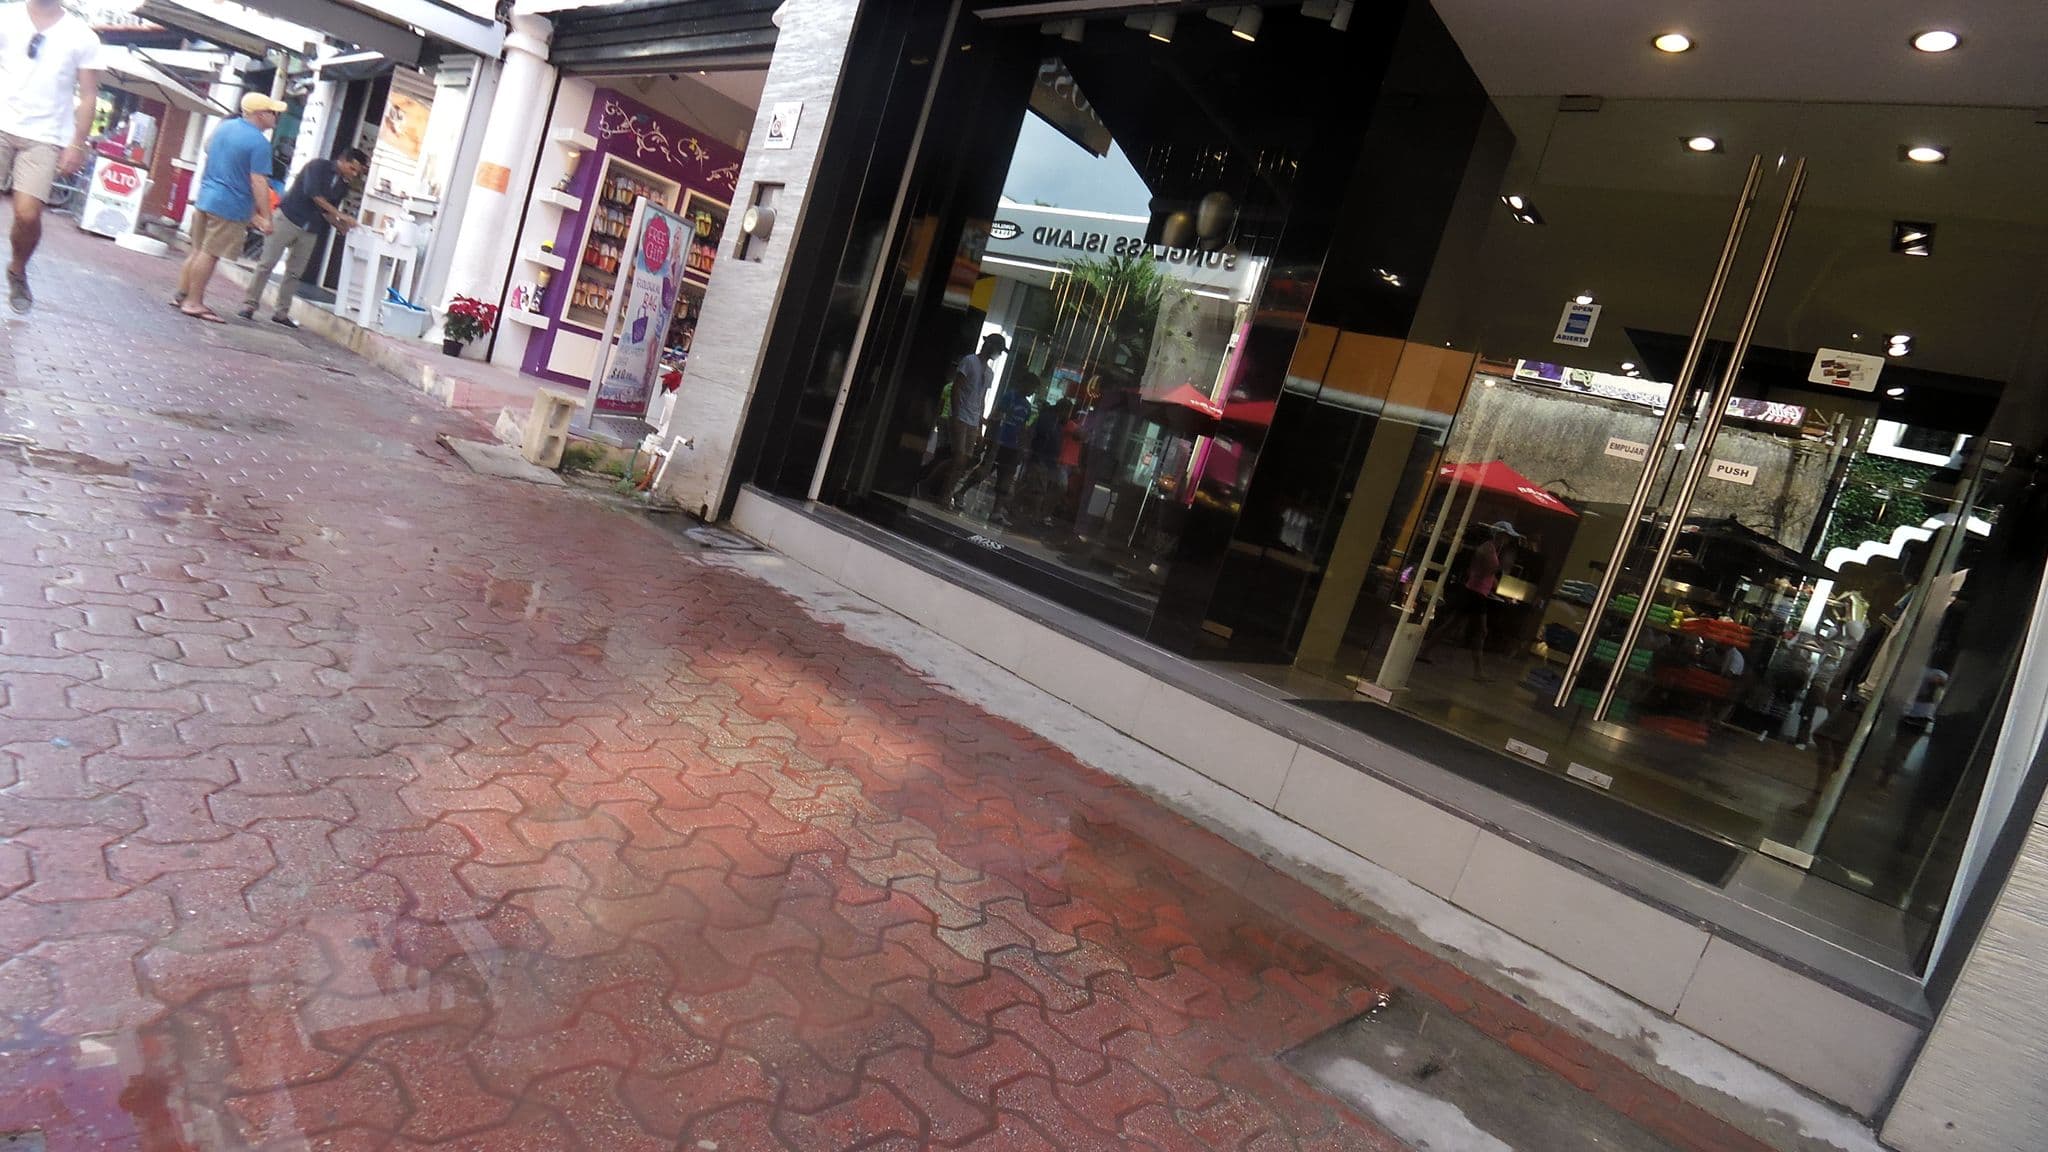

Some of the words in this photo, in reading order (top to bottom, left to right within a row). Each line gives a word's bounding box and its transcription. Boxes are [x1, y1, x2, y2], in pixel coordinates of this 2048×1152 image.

[103, 168, 137, 189] ALTO
[648, 226, 667, 246] FREE
[1572, 305, 1593, 313] OPEN
[1555, 334, 1589, 343] ABIERTO
[1609, 442, 1644, 456] EMPUJAR
[1716, 465, 1750, 478] PUSH
